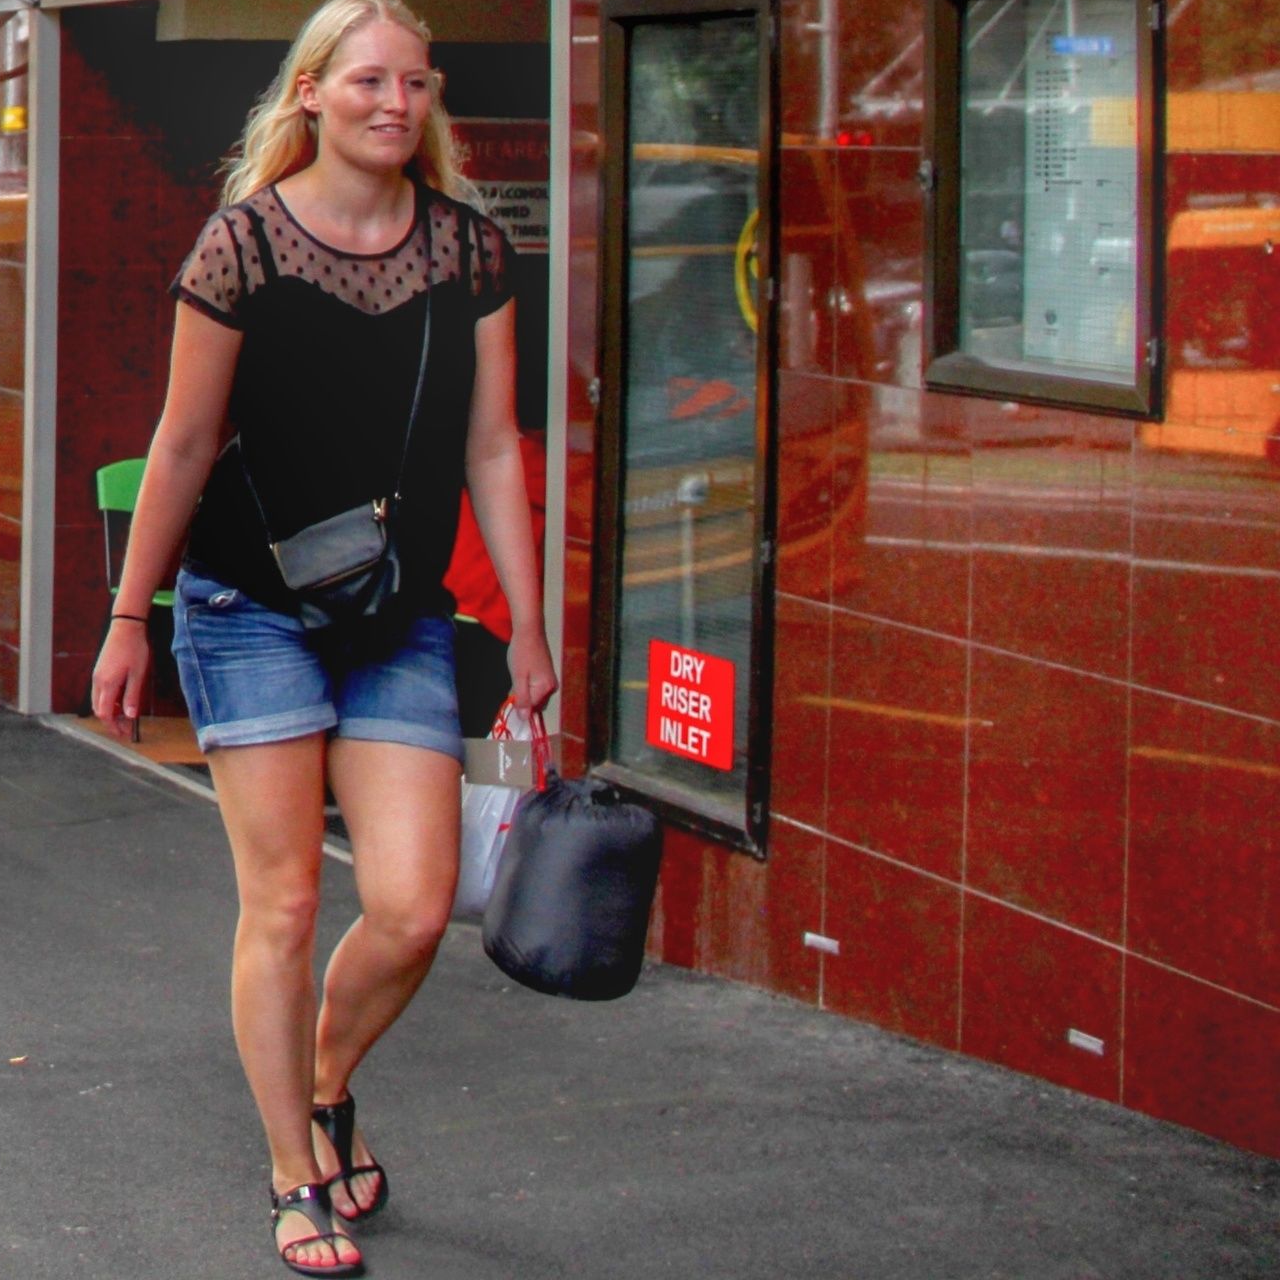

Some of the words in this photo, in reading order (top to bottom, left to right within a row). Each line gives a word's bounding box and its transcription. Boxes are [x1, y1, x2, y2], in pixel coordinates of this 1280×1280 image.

[670, 650, 705, 684] DRY
[661, 682, 711, 722] RISER
[660, 716, 711, 757] INLET
